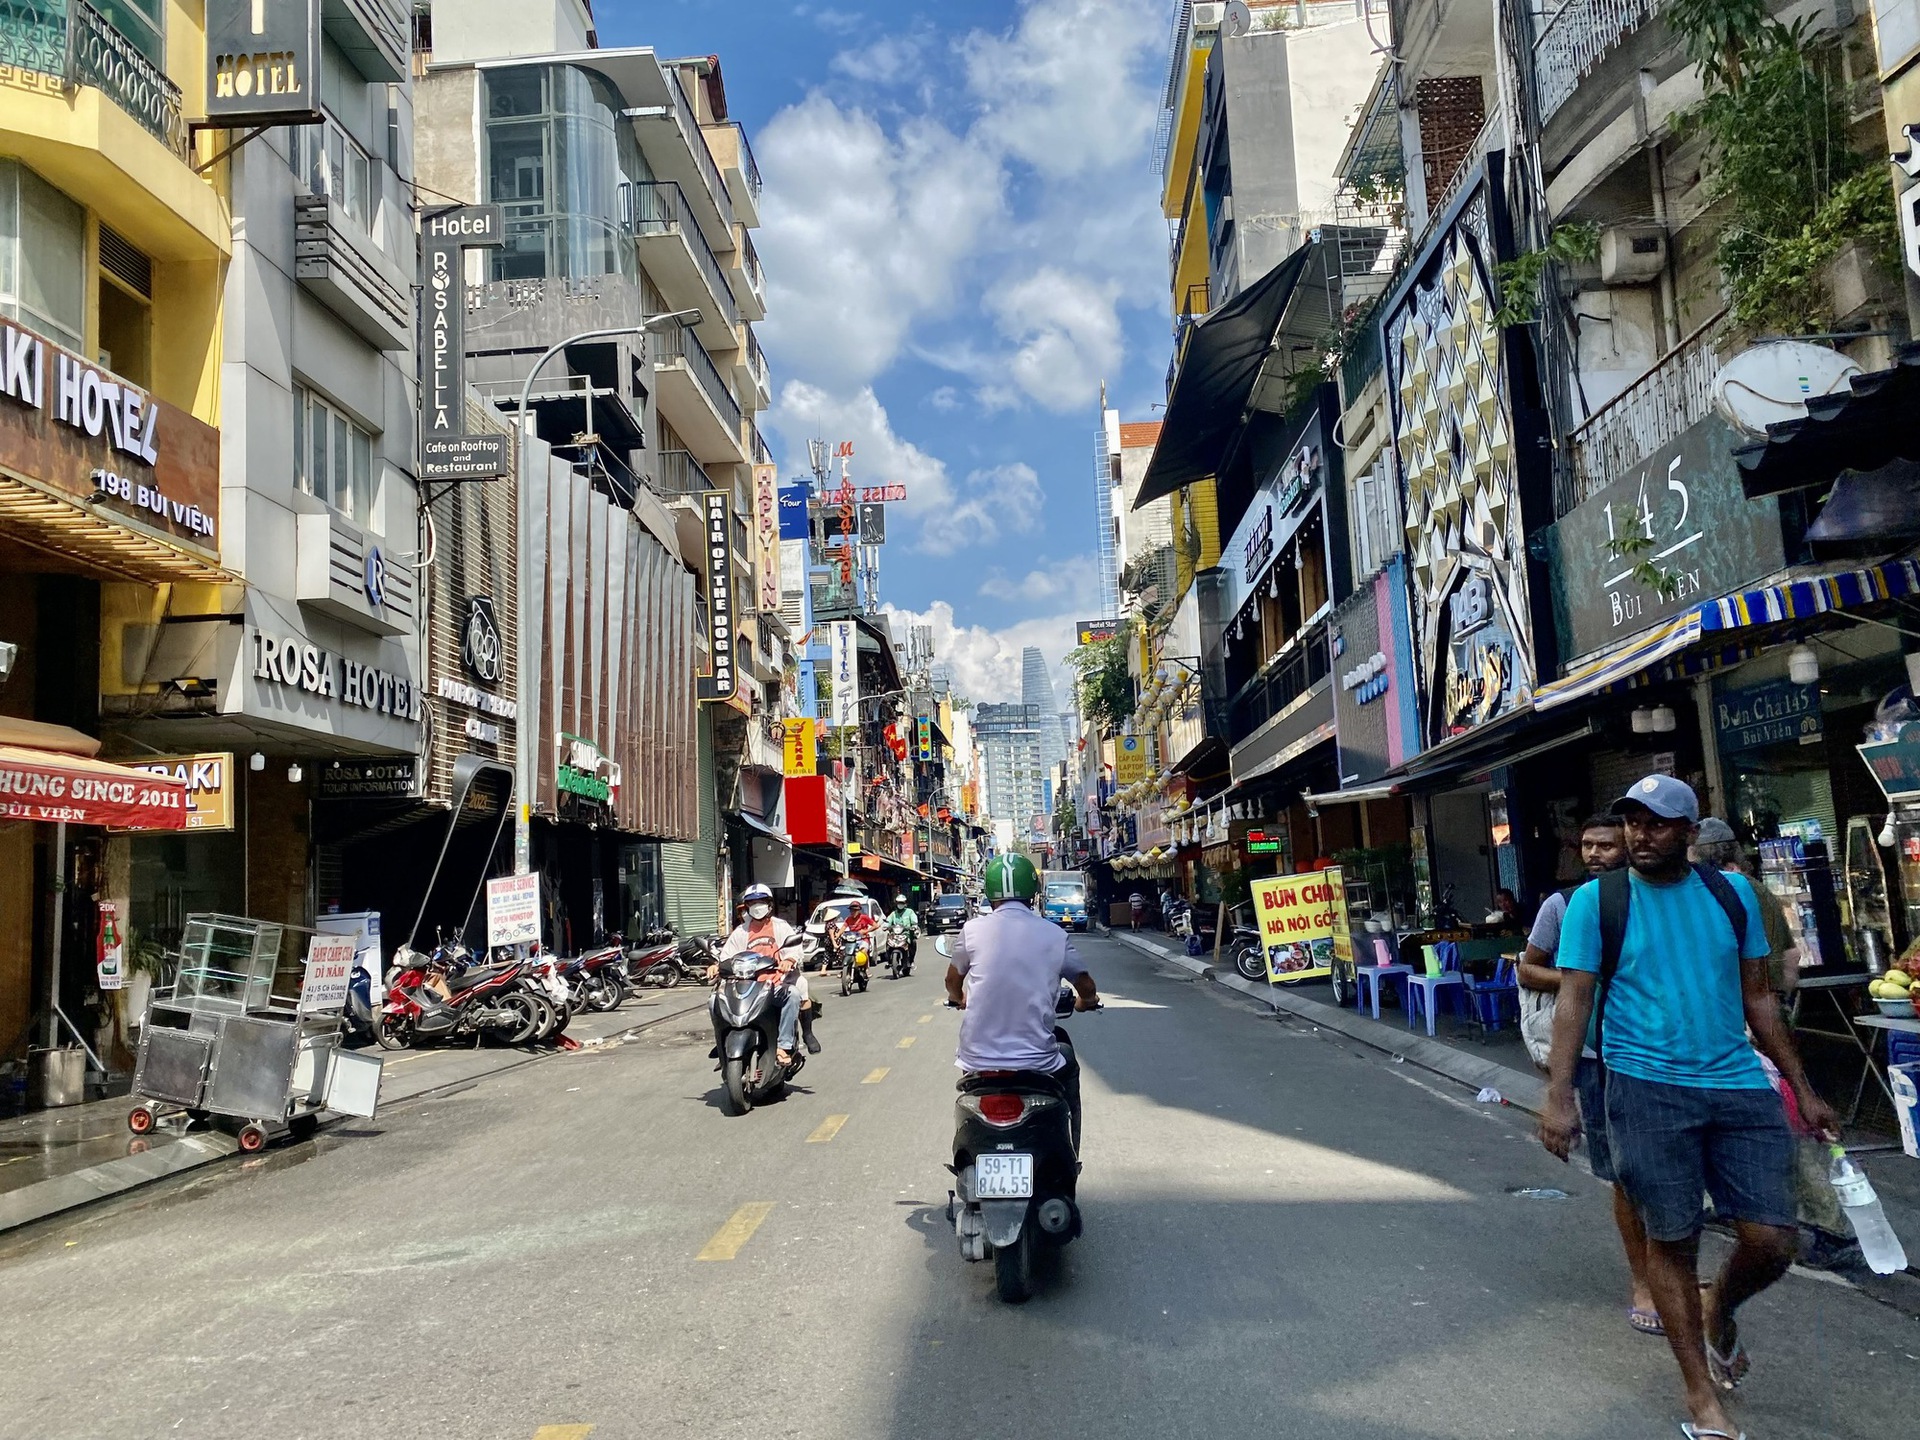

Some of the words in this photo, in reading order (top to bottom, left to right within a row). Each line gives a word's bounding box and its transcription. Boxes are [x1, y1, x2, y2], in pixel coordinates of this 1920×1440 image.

[215, 51, 302, 98] HOTEL
[431, 215, 490, 237] Hotel
[56, 354, 158, 466] HOTEL
[426, 442, 447, 453] Cafe
[448, 444, 460, 452] on
[461, 440, 498, 454] Rooftop
[453, 454, 471, 462] and
[426, 462, 497, 473] Restaurant
[97, 469, 132, 501] 198
[173, 501, 213, 537] VIỆN
[757, 468, 775, 553] HAPPY
[1603, 454, 1689, 562] 145
[709, 496, 724, 543] HAIR
[712, 547, 725, 571] OF
[713, 575, 728, 611] THE
[762, 555, 777, 609] INN
[1609, 591, 1642, 627] BÙI
[714, 615, 728, 651] DOG
[253, 628, 337, 699] ROSA
[340, 659, 421, 722] HOTEL
[716, 655, 730, 691] BAR
[438, 678, 467, 703] HAIR
[465, 719, 500, 743] CLUB
[325, 767, 361, 780] ROSA
[366, 765, 412, 779] HOTEL
[1119, 763, 1144, 771] LAPTOP
[71, 778, 135, 805] SINCE
[139, 789, 179, 808] 2011
[322, 783, 348, 793] TOUR
[350, 780, 415, 792] INFORMATION
[39, 806, 86, 822] VIỆN
[516, 876, 535, 890] SERVICE
[1262, 886, 1297, 910] BÚN
[494, 915, 508, 924] OPEN
[509, 911, 534, 921] NONSTOP
[1267, 917, 1285, 934] HÀ
[1287, 913, 1311, 934] NỘI
[984, 1157, 1022, 1175] 59-T1
[979, 1176, 1029, 1195] 844.55
